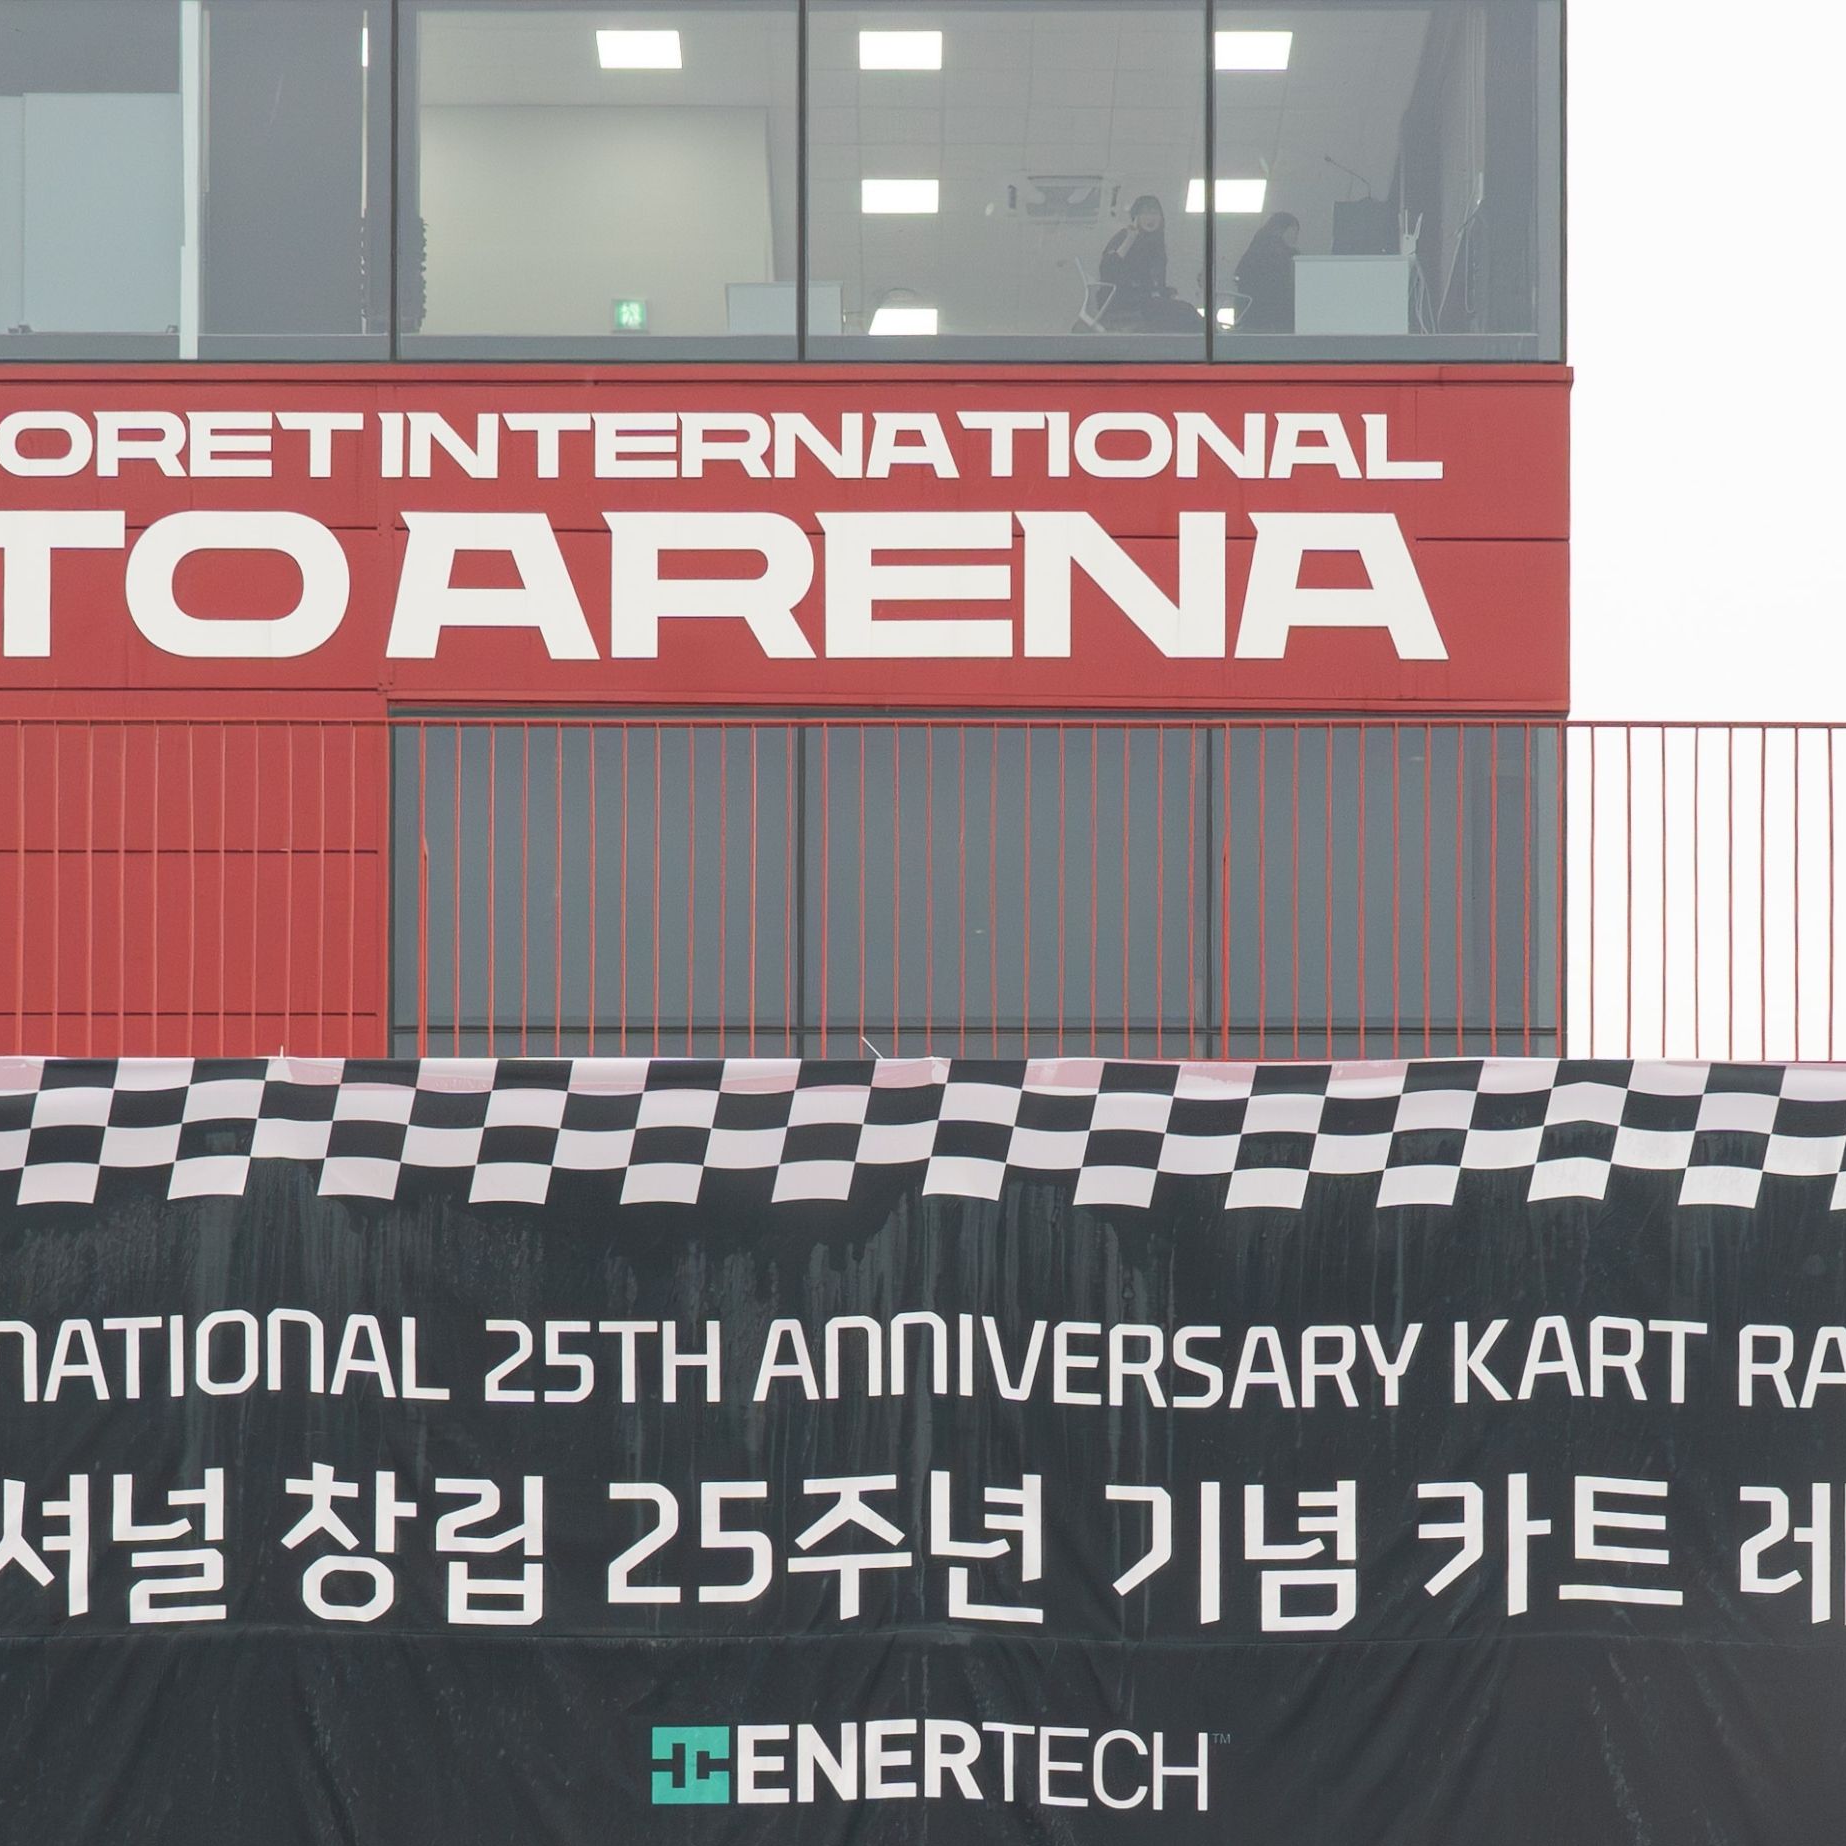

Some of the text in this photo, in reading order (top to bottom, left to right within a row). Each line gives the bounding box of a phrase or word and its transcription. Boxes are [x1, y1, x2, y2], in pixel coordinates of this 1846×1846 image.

[378, 411, 1443, 479] INTERNATIONAL
[386, 511, 1448, 659] ARENA
[485, 1320, 720, 1403] 25TH
[753, 1311, 1422, 1408] ANNIVERSARY
[1454, 1316, 1707, 1403] KART
[281, 1462, 543, 1625] 창립
[608, 1471, 1043, 1623] 25주년
[1106, 1482, 1356, 1631] 기념
[1418, 1473, 1683, 1616] 카트
[738, 1719, 1208, 1811] ENERTECH
